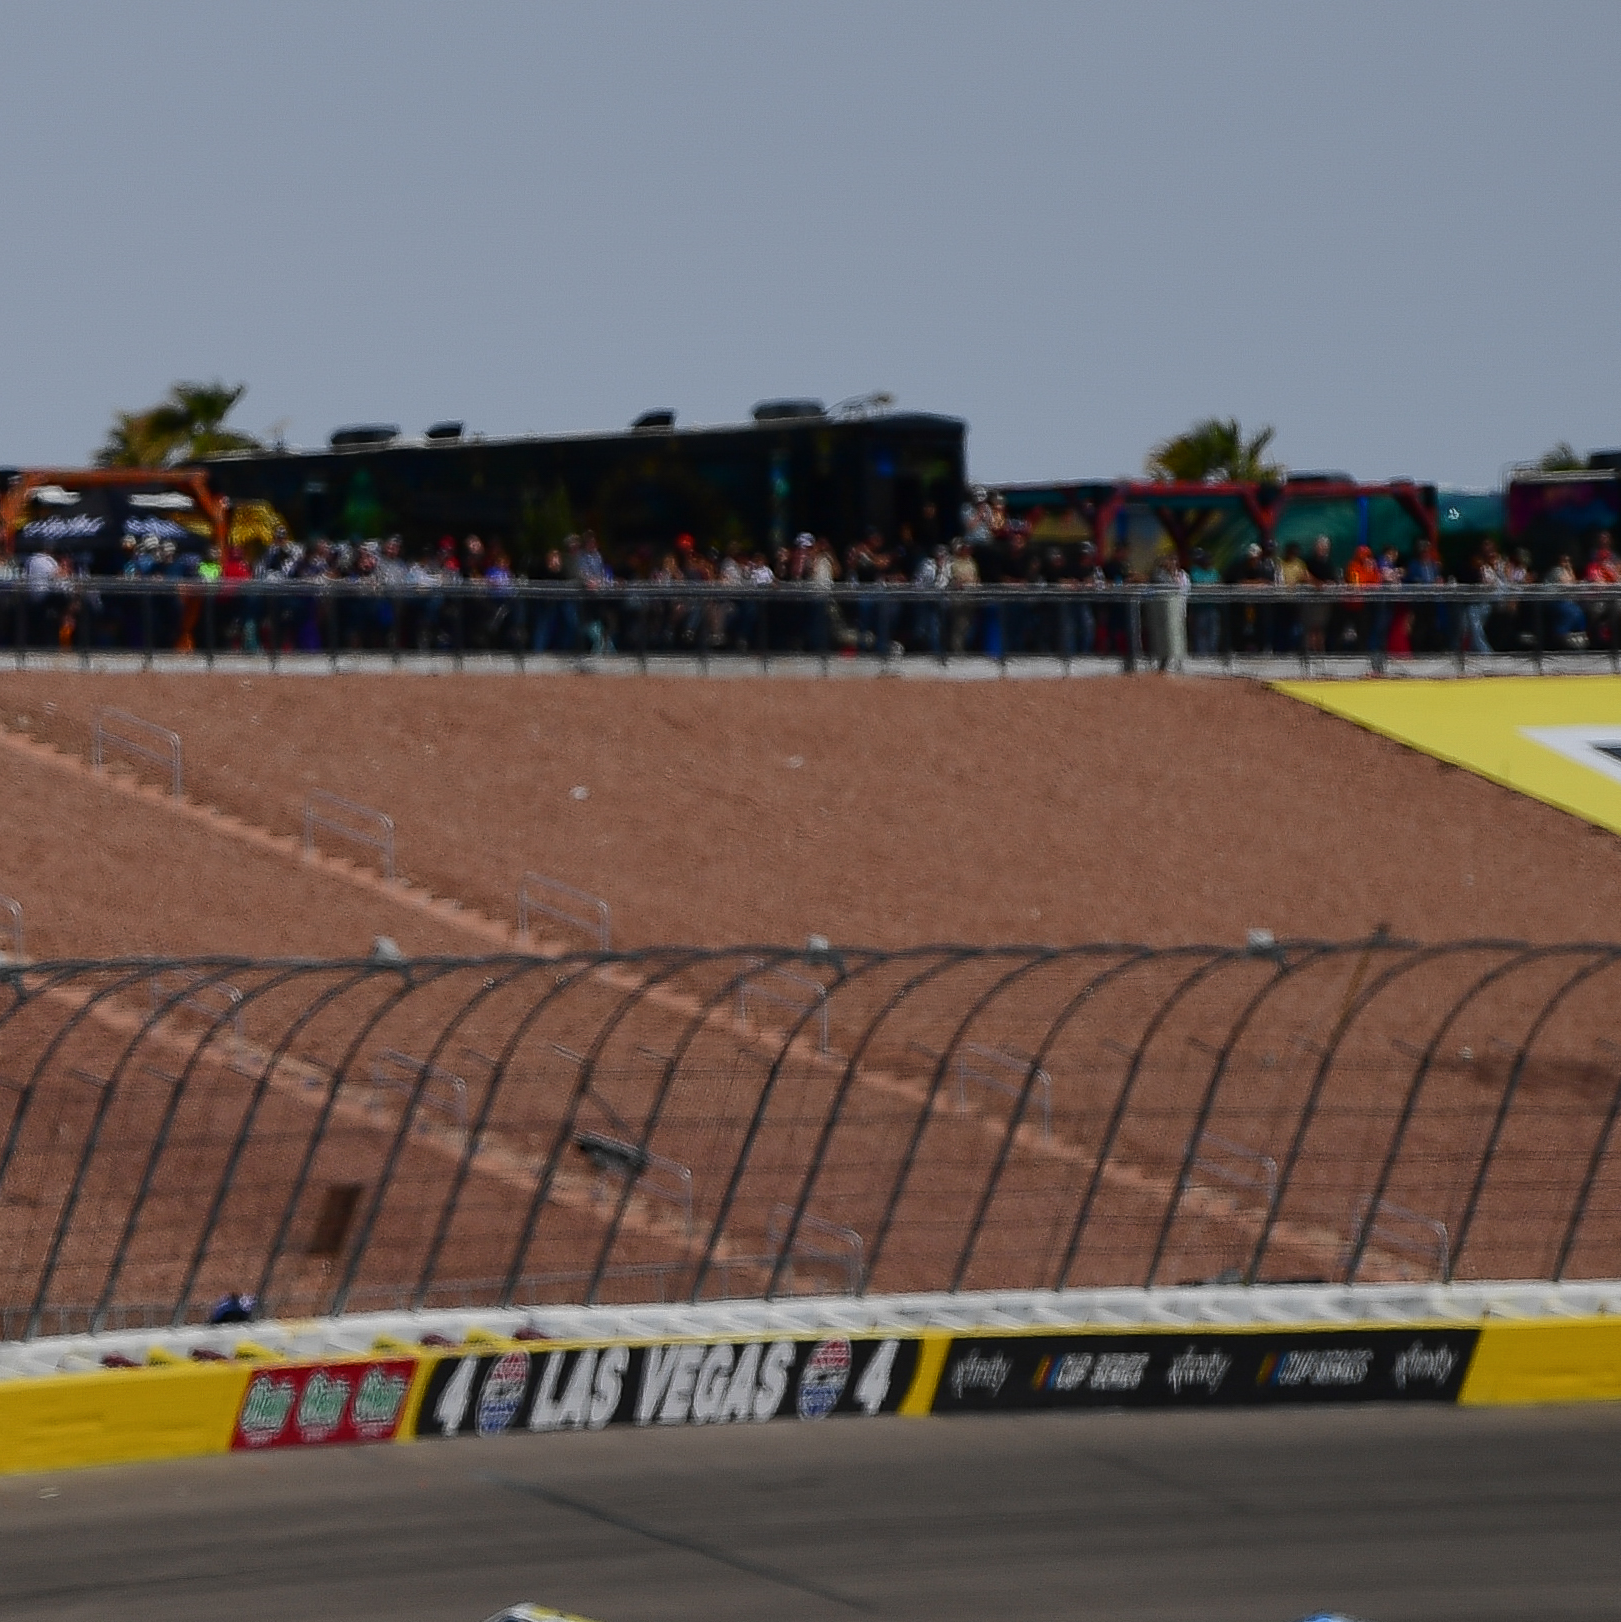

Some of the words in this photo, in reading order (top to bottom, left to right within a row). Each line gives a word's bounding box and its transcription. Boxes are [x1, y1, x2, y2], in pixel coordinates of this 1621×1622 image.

[434, 1354, 481, 1437] 4
[527, 1346, 630, 1433] LAS
[634, 1341, 797, 1427] VEGAS
[854, 1337, 901, 1418] 4
